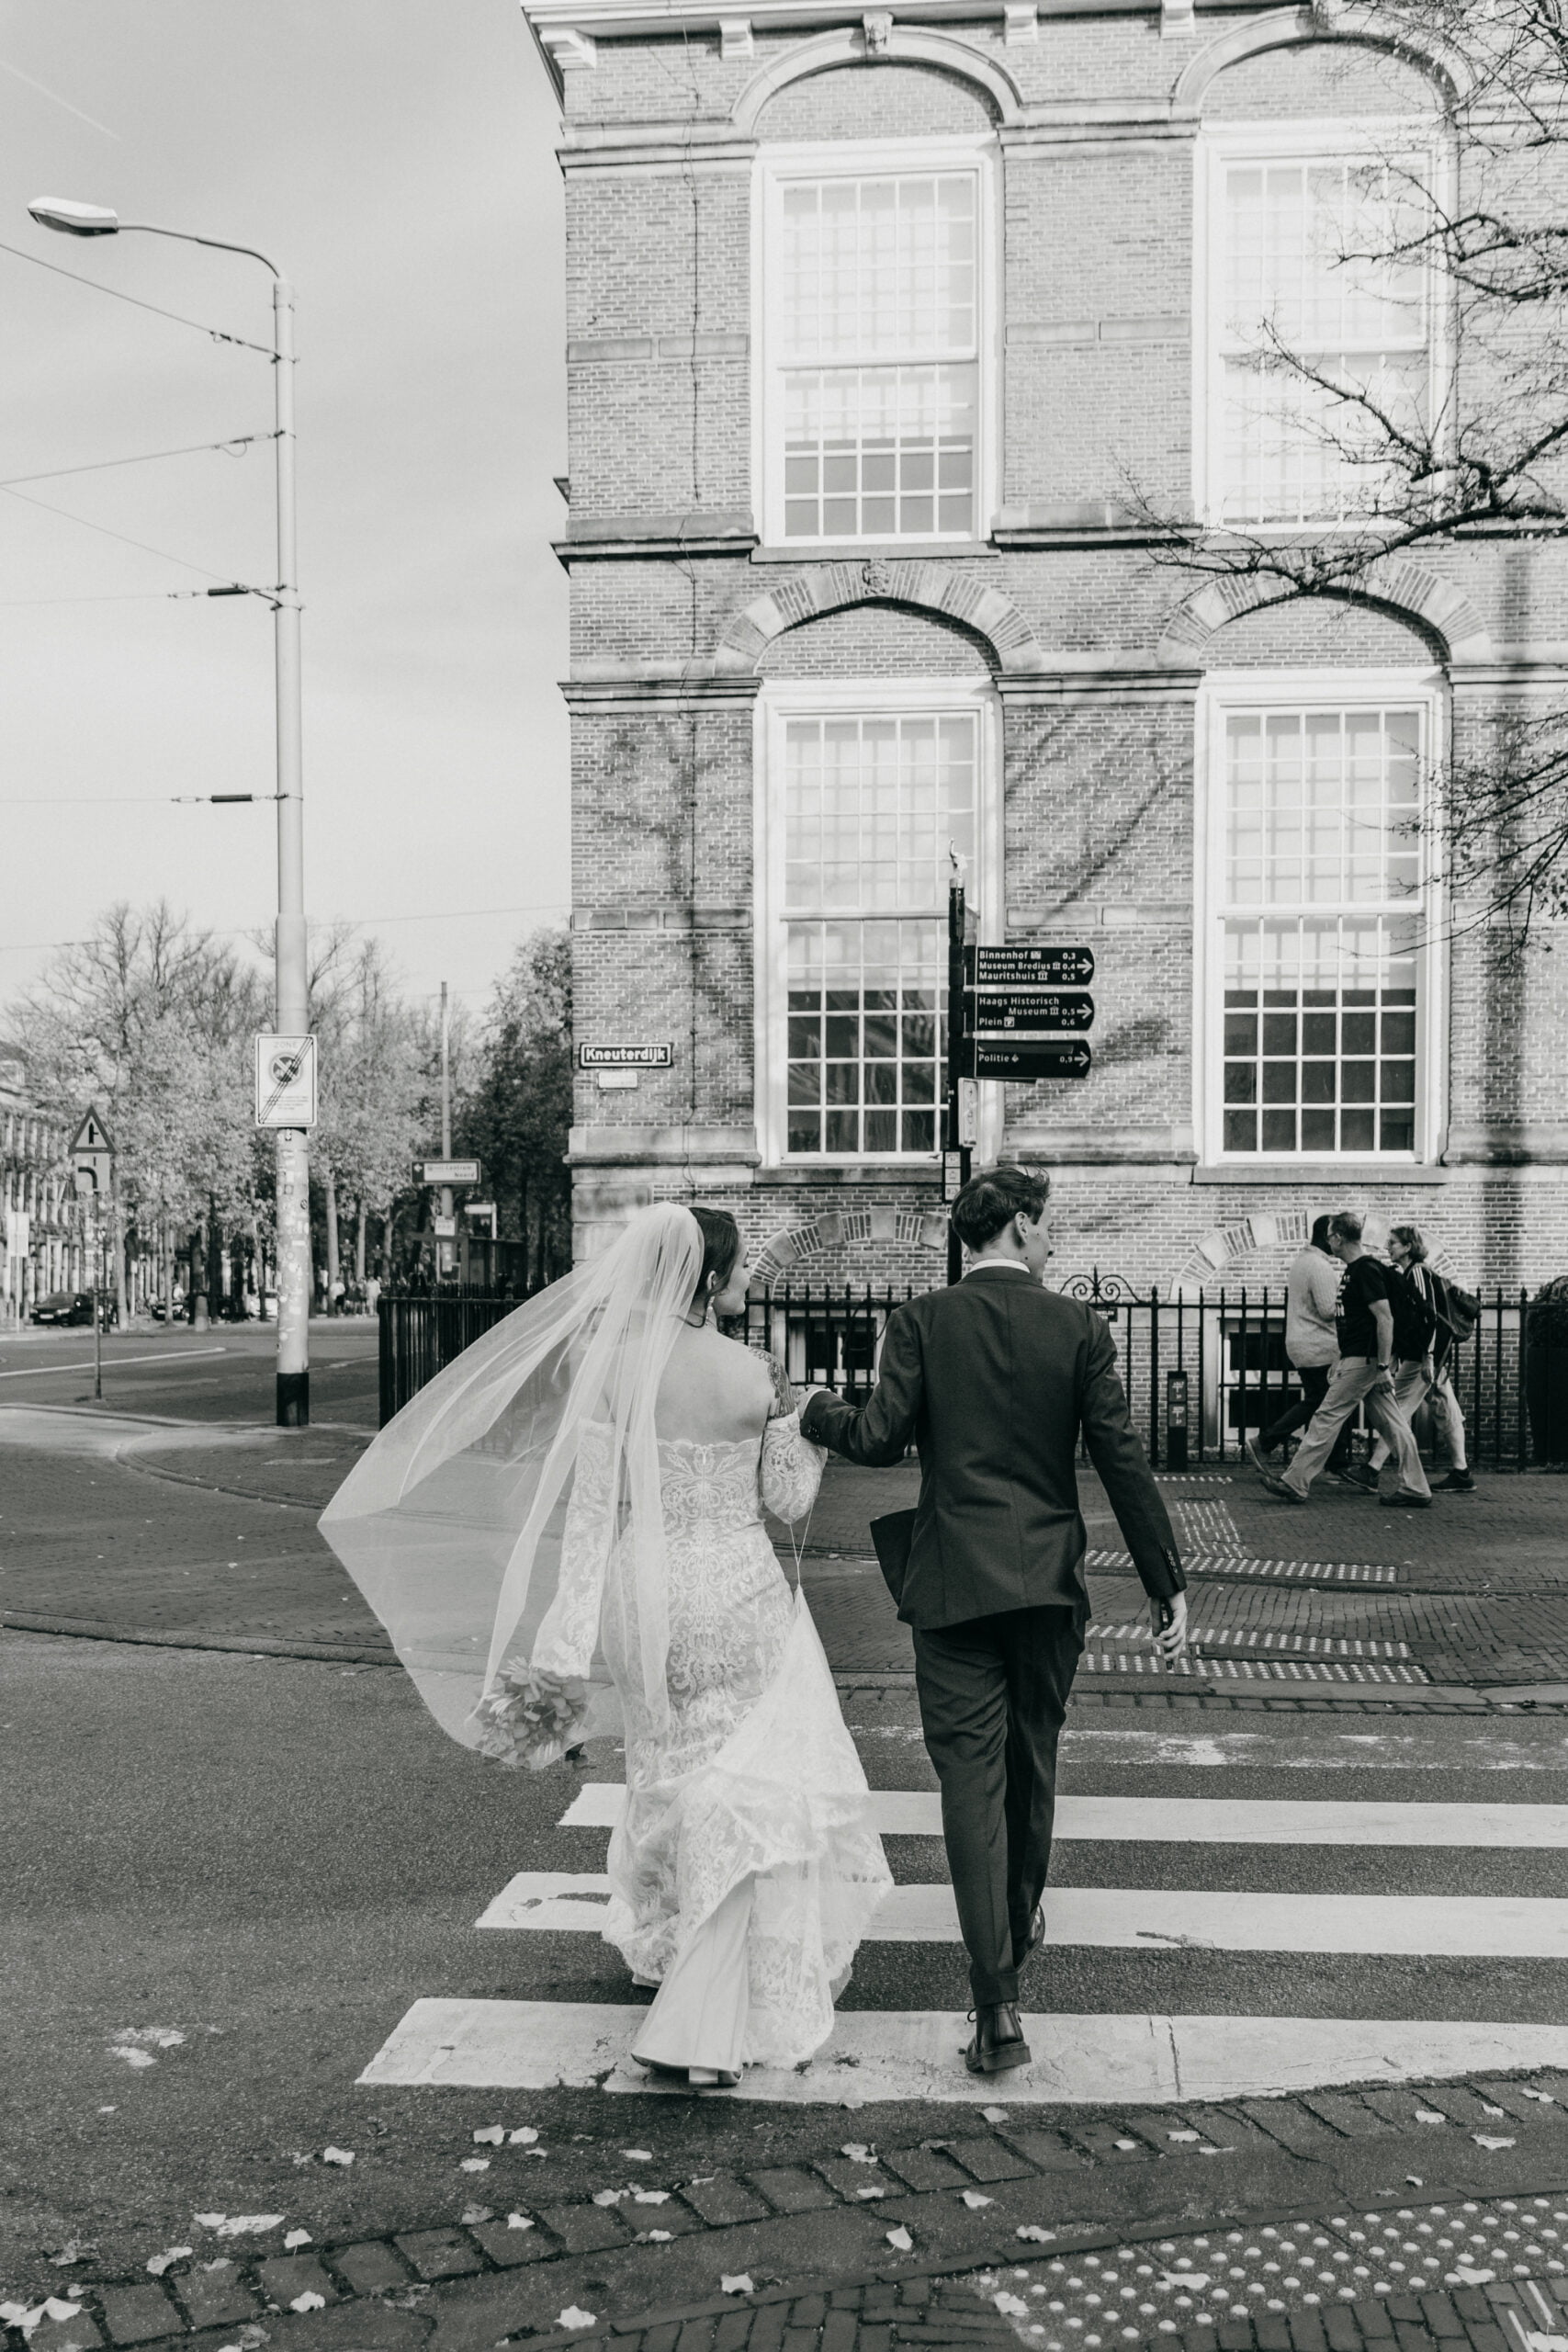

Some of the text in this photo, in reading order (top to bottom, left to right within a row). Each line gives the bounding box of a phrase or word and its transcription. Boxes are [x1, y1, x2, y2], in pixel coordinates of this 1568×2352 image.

[979, 950, 1076, 961] Binnenhof 0,3
[979, 961, 1076, 971] Museum Bredius 0,4
[978, 971, 1035, 980] Mauritshuis
[979, 997, 1059, 1007] Haags Historisch
[1009, 1007, 1048, 1016] Museum
[979, 1017, 1003, 1026] Plein
[585, 1047, 666, 1062] Kneuterdijk
[978, 1054, 1010, 1063] Politie
